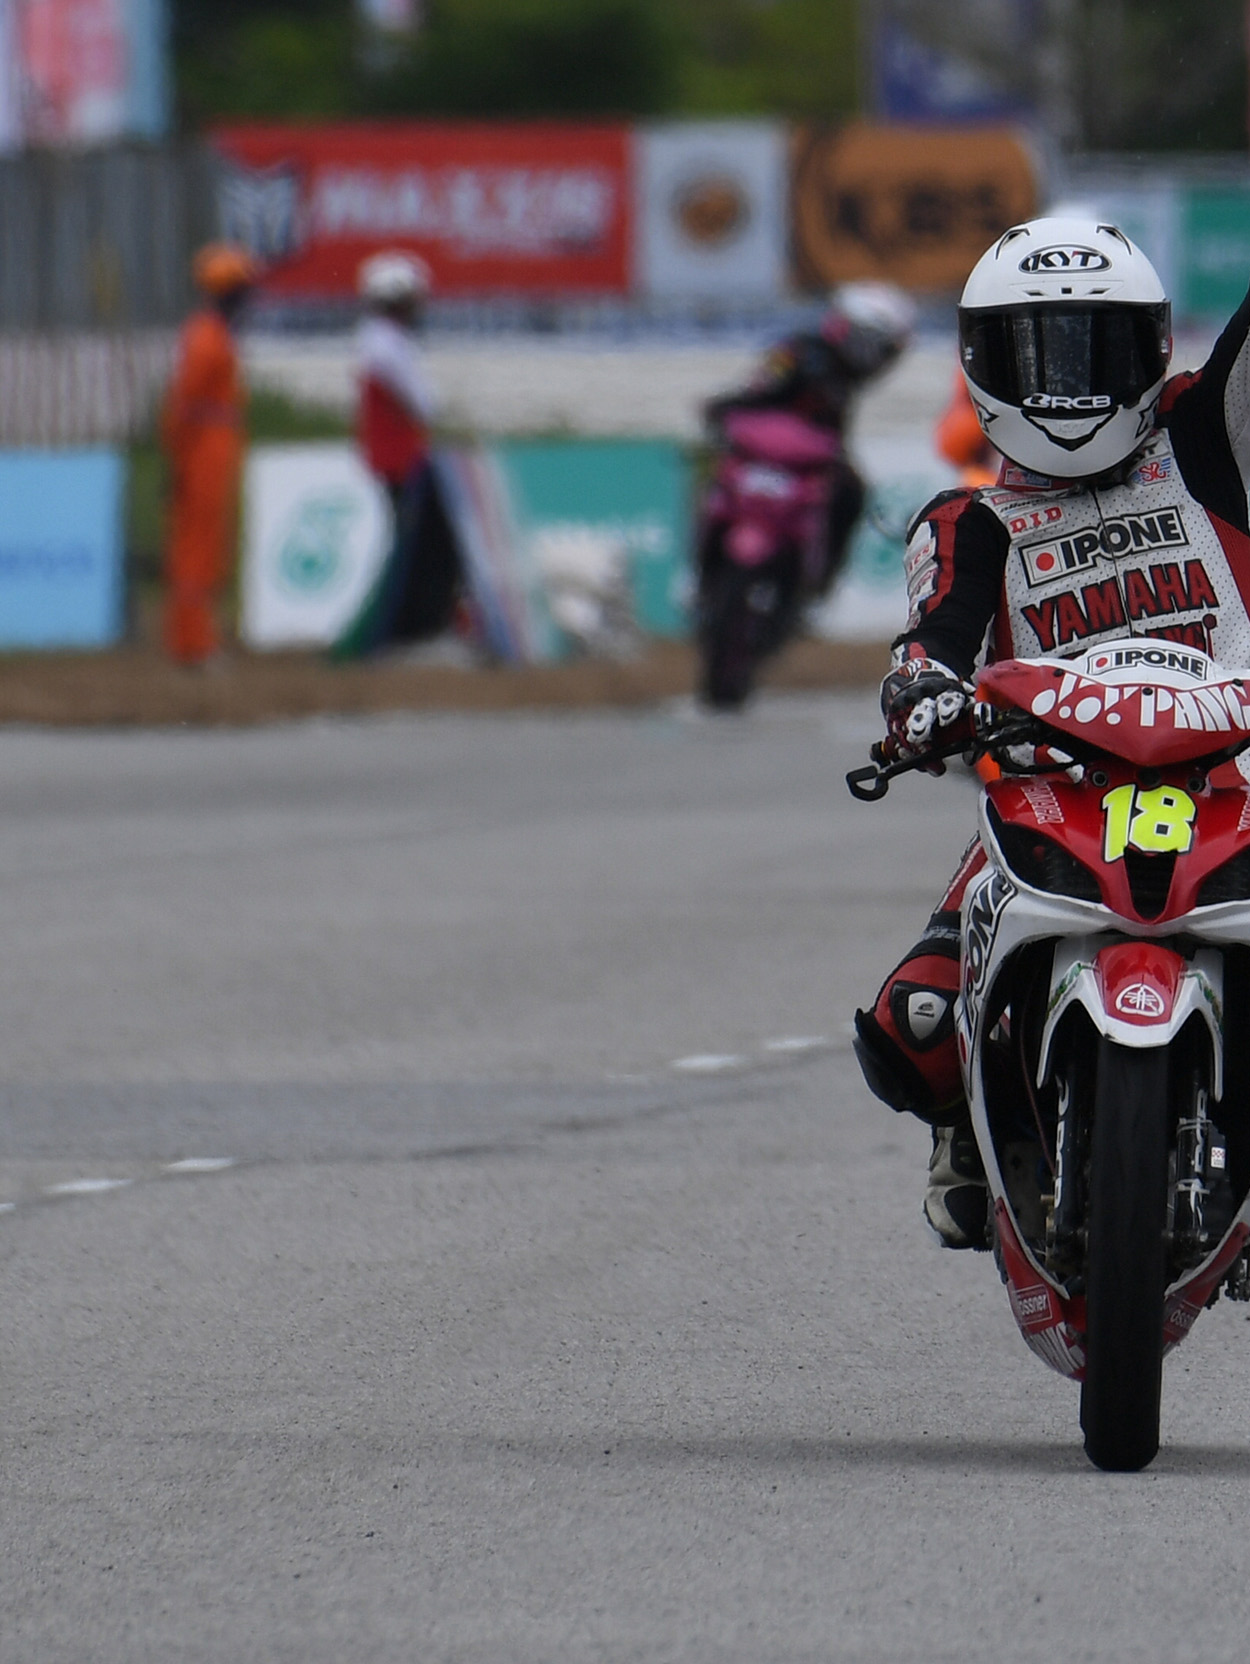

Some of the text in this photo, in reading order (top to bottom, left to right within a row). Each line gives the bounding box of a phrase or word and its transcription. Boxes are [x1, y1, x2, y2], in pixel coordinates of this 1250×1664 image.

[1028, 249, 1102, 272] KYT
[1060, 512, 1182, 569] IPONE
[1020, 558, 1220, 652] YAMAHA
[1114, 651, 1205, 675] IPONE
[1101, 783, 1197, 863] 18
